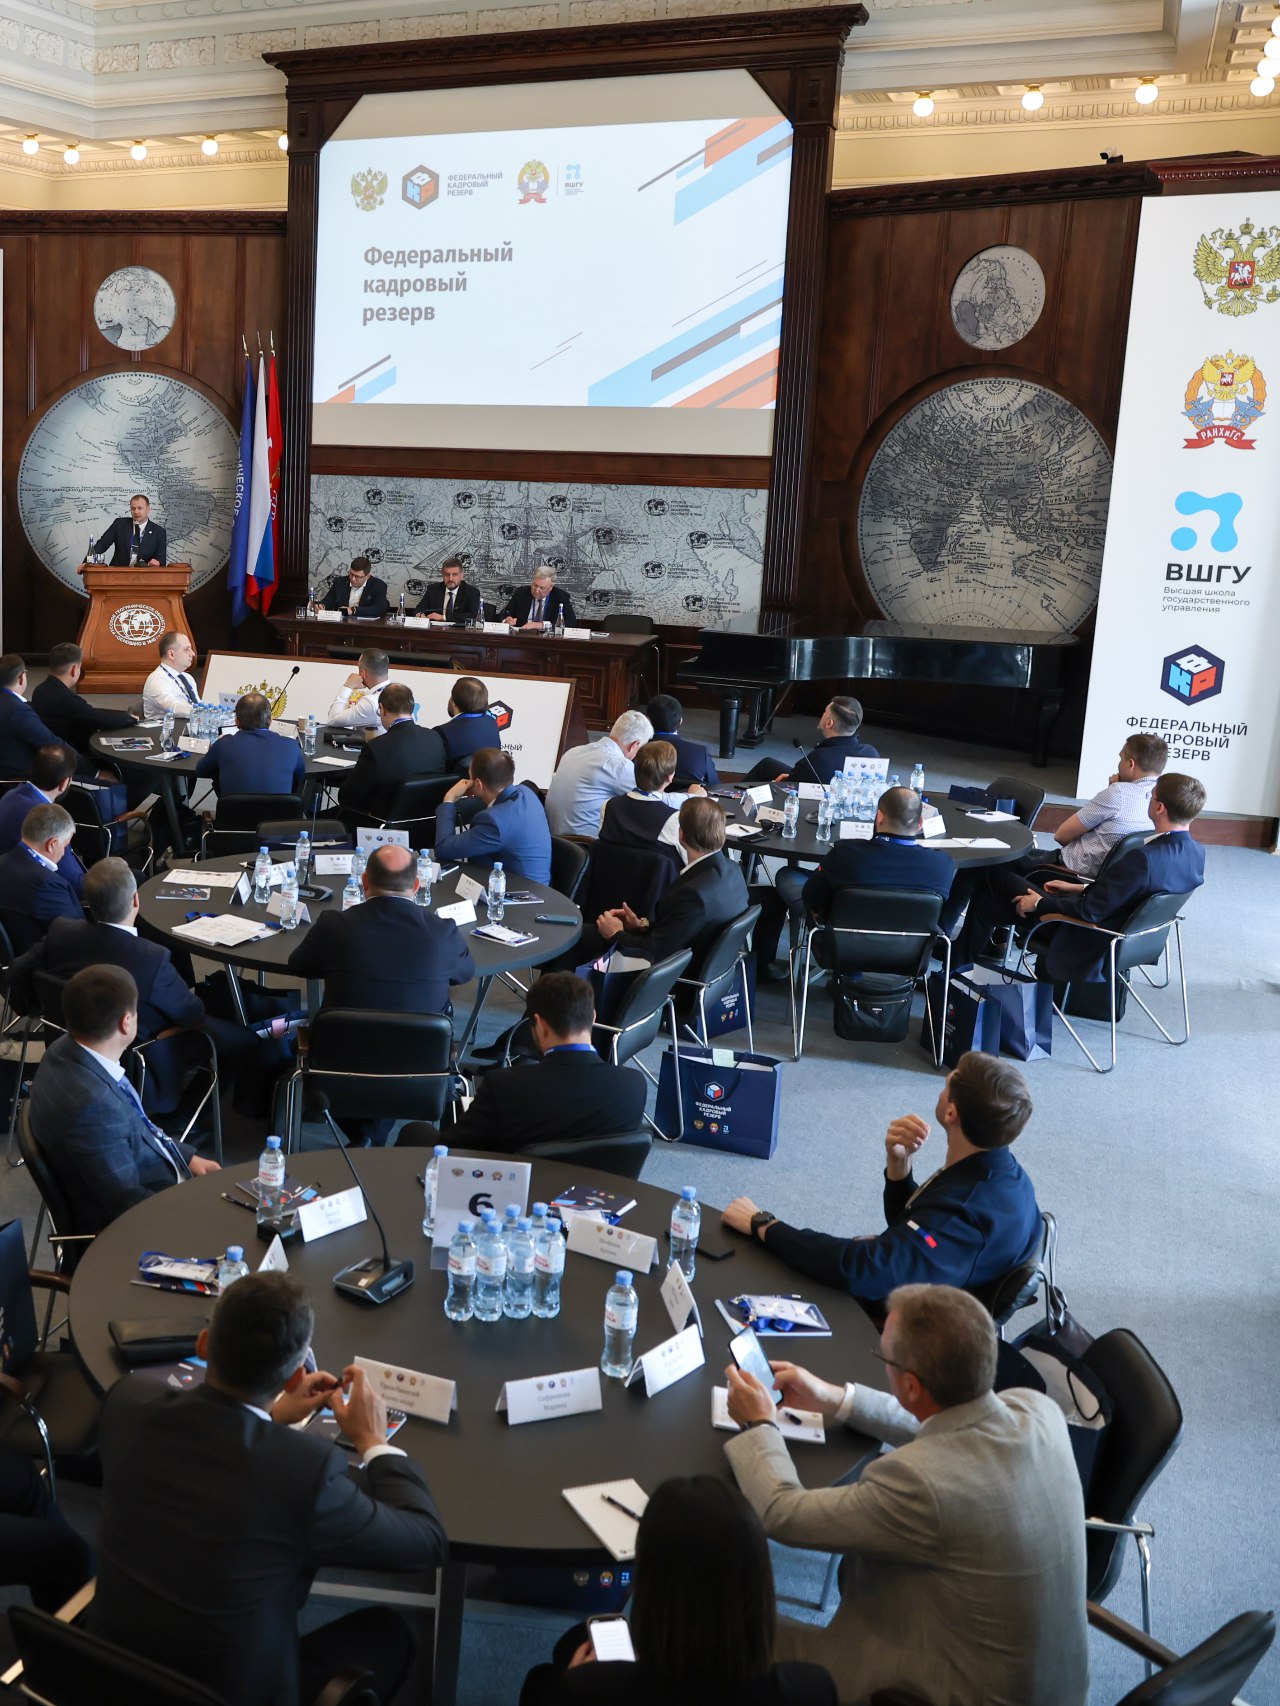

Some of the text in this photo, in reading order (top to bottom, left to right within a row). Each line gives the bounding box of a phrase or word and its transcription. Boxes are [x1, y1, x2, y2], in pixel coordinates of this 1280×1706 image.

[447, 172, 503, 181] ФЕДЕРАЛЬНЫЙ
[447, 180, 489, 189] КАДРОВЫЙ
[363, 240, 513, 269] Федеральный
[363, 271, 468, 297] кадровый
[362, 305, 435, 326] резерв
[1200, 426, 1242, 442] РАНХиГС
[1165, 563, 1252, 584] ВШГУ
[1163, 586, 1236, 597] Высшая школа
[1161, 604, 1221, 613] управления
[1162, 595, 1251, 607] государственного
[1126, 716, 1248, 736] ФЕДЕРАЛЬНЫЙ
[1140, 731, 1230, 749] ДРОВЫЙ
[1167, 747, 1211, 761] ЗЕРВ
[468, 1193, 493, 1217] 6
